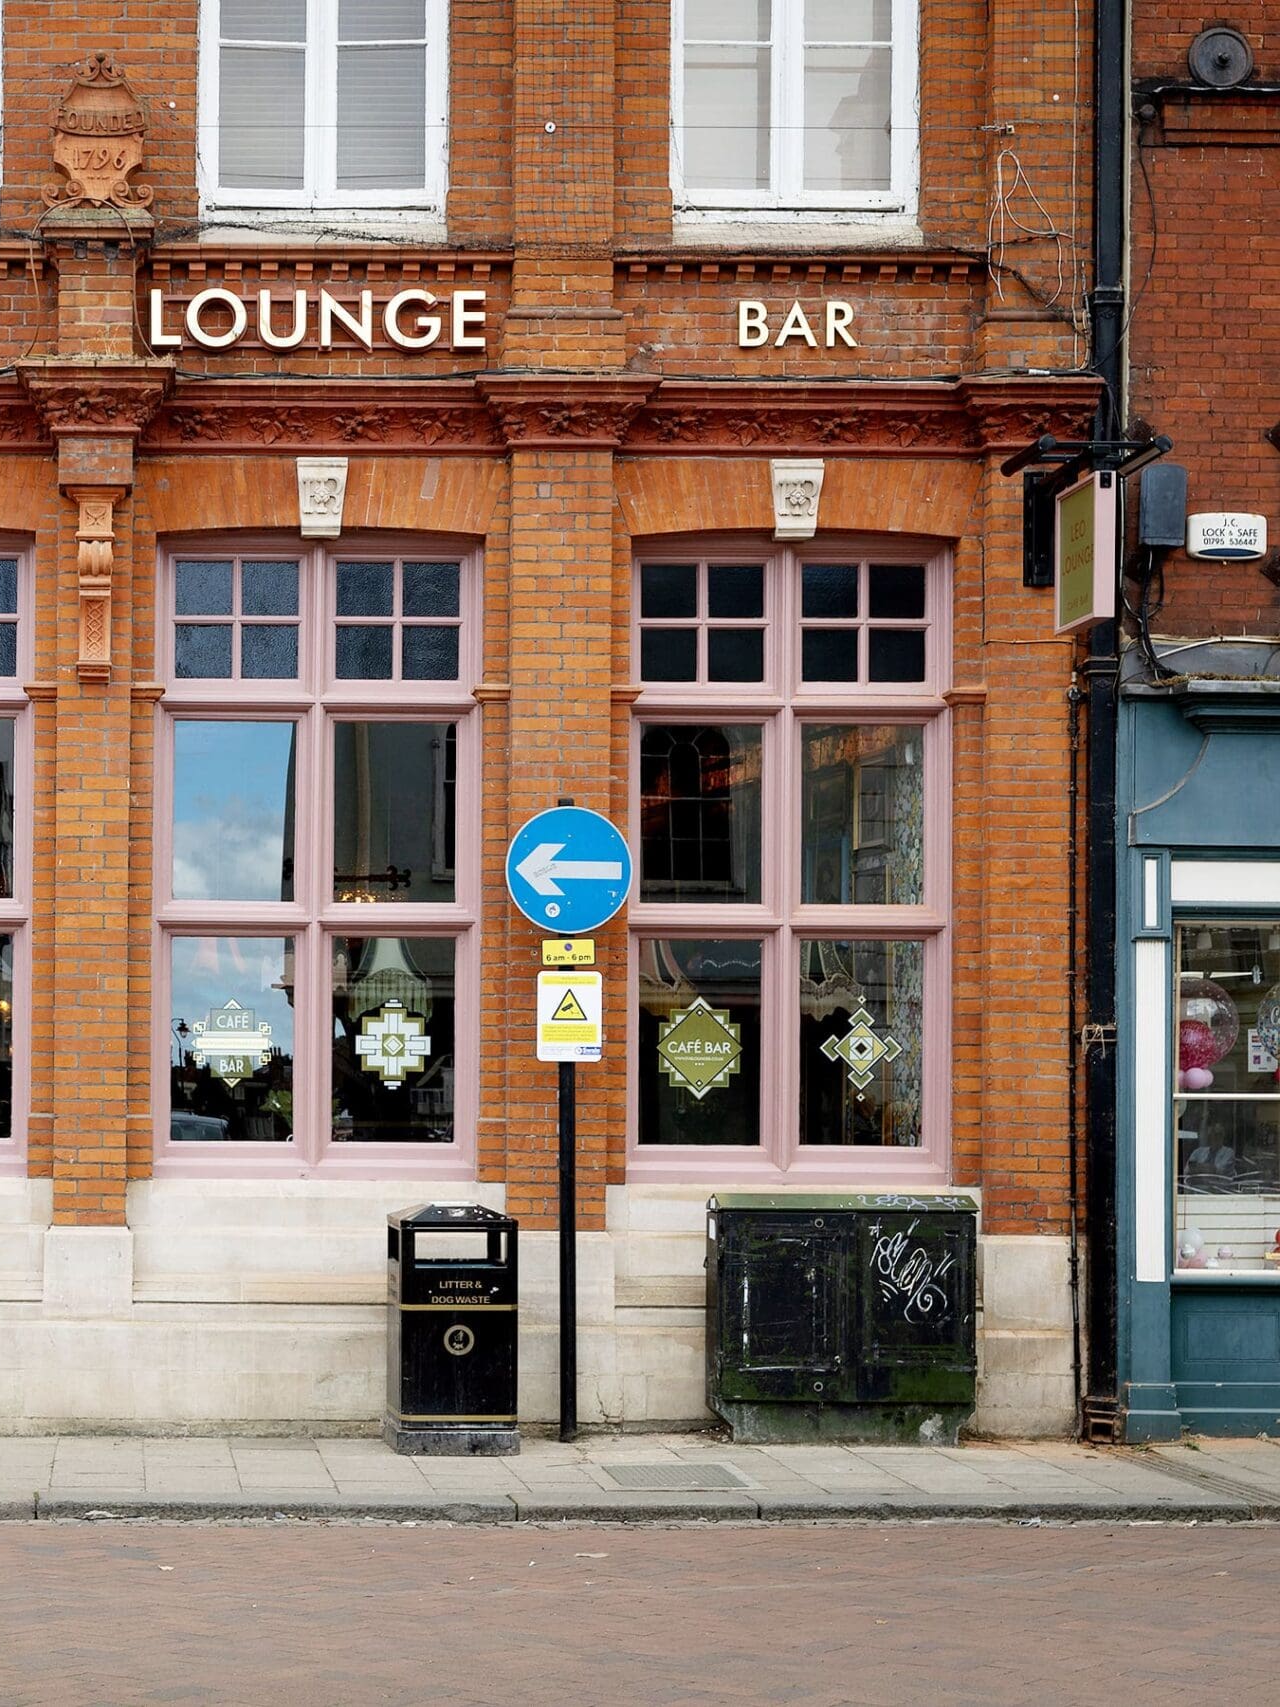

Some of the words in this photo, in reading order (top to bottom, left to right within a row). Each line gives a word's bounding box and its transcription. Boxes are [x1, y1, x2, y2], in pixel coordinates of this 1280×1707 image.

[72, 147, 127, 170] 1796
[149, 287, 488, 352] LOUNGE
[737, 299, 860, 349] BAR
[1223, 518, 1238, 527] J.C.
[1070, 519, 1087, 542] LEO
[1202, 528, 1225, 537] LOCK
[1237, 528, 1258, 537] SAFE
[1229, 538, 1257, 546] 536447
[571, 953, 577, 961] 6
[216, 1011, 249, 1029] CAFÉ
[667, 1039, 702, 1054] CAFÉ
[705, 1041, 731, 1054] BAR
[219, 1059, 244, 1073] BAR
[439, 1280, 473, 1289] LITTER
[474, 1280, 482, 1289] &
[431, 1295, 454, 1304] DOG
[455, 1295, 491, 1304] WASTE
